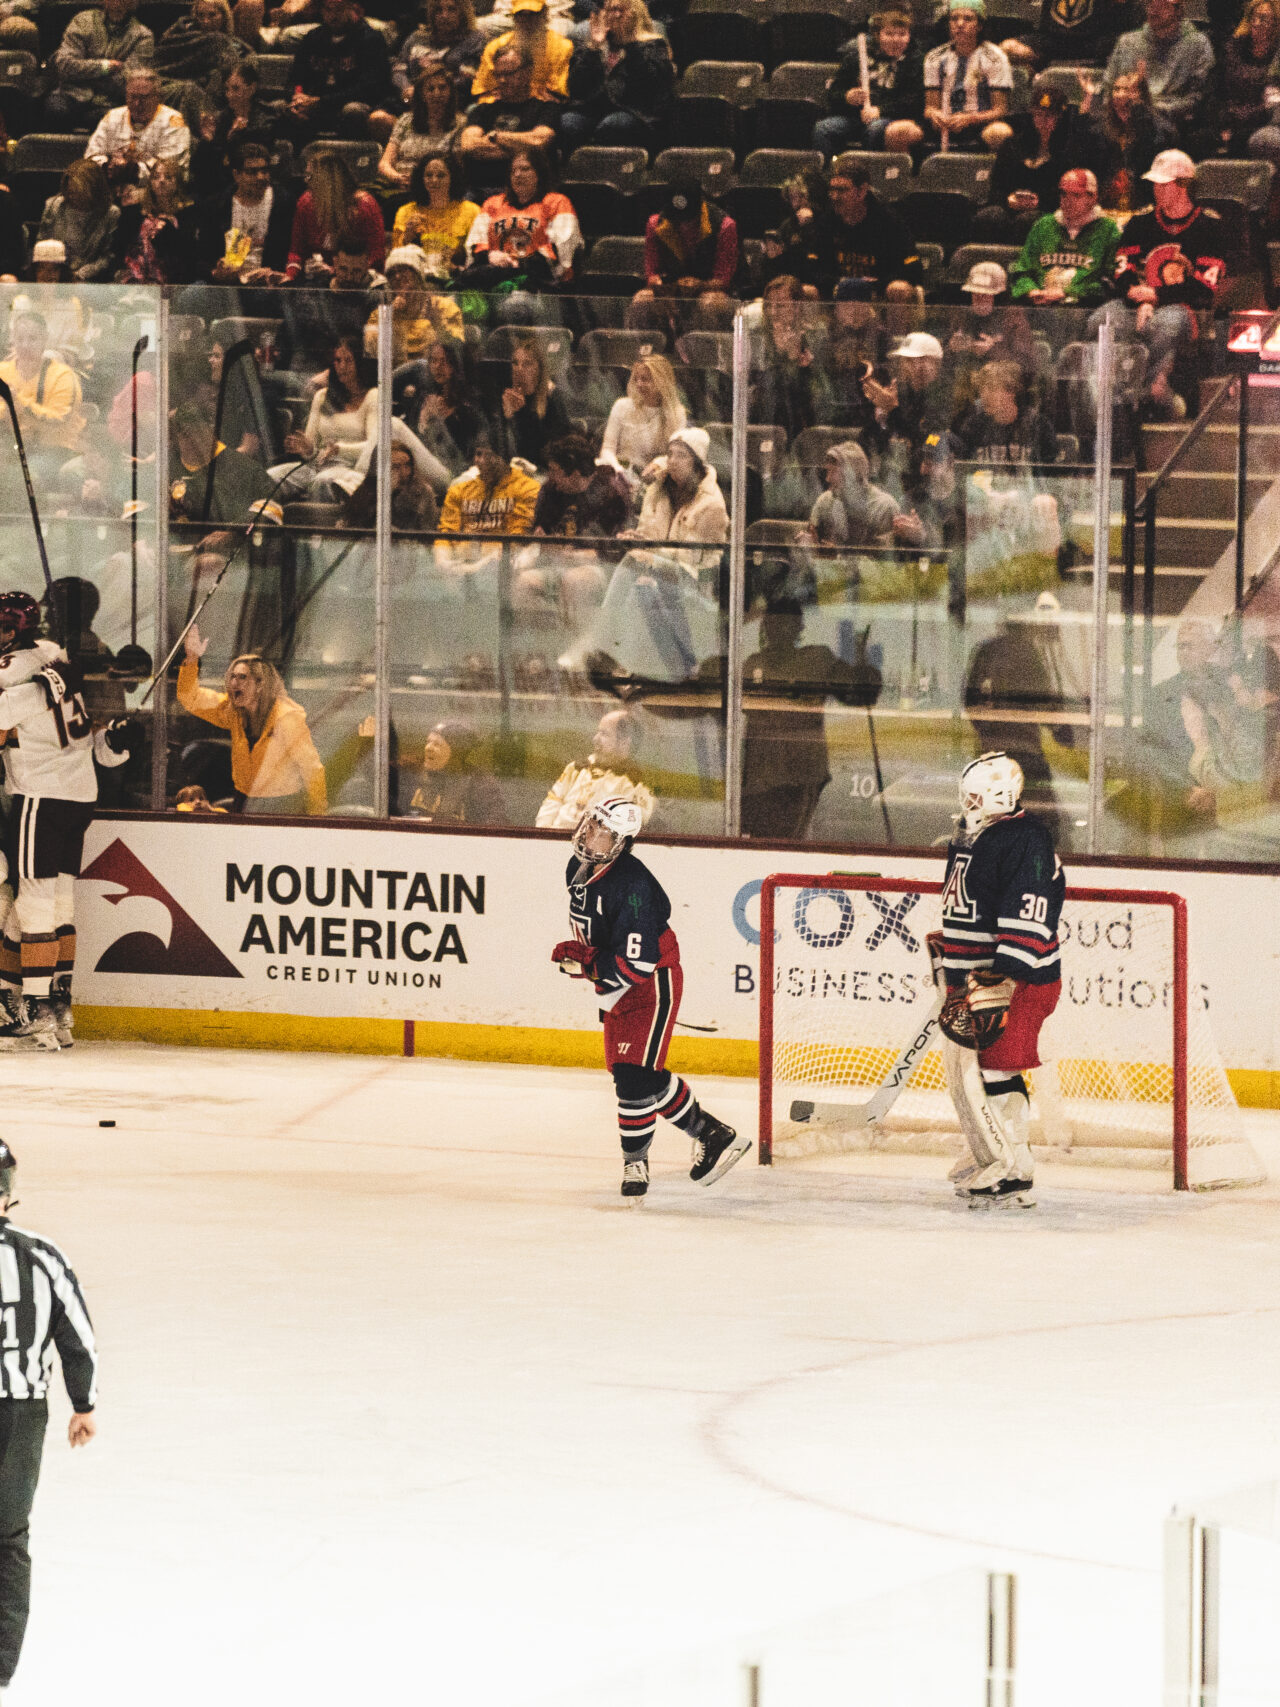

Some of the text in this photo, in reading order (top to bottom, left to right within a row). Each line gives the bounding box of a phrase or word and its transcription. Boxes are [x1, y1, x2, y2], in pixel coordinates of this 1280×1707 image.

[849, 774, 876, 799] 10
[226, 863, 485, 915] MOUNTAIN
[732, 879, 920, 953] COX
[1019, 893, 1048, 923] 30
[239, 914, 469, 964] AMERICA
[625, 932, 643, 959] 6
[266, 965, 442, 989] CREDIT UNION
